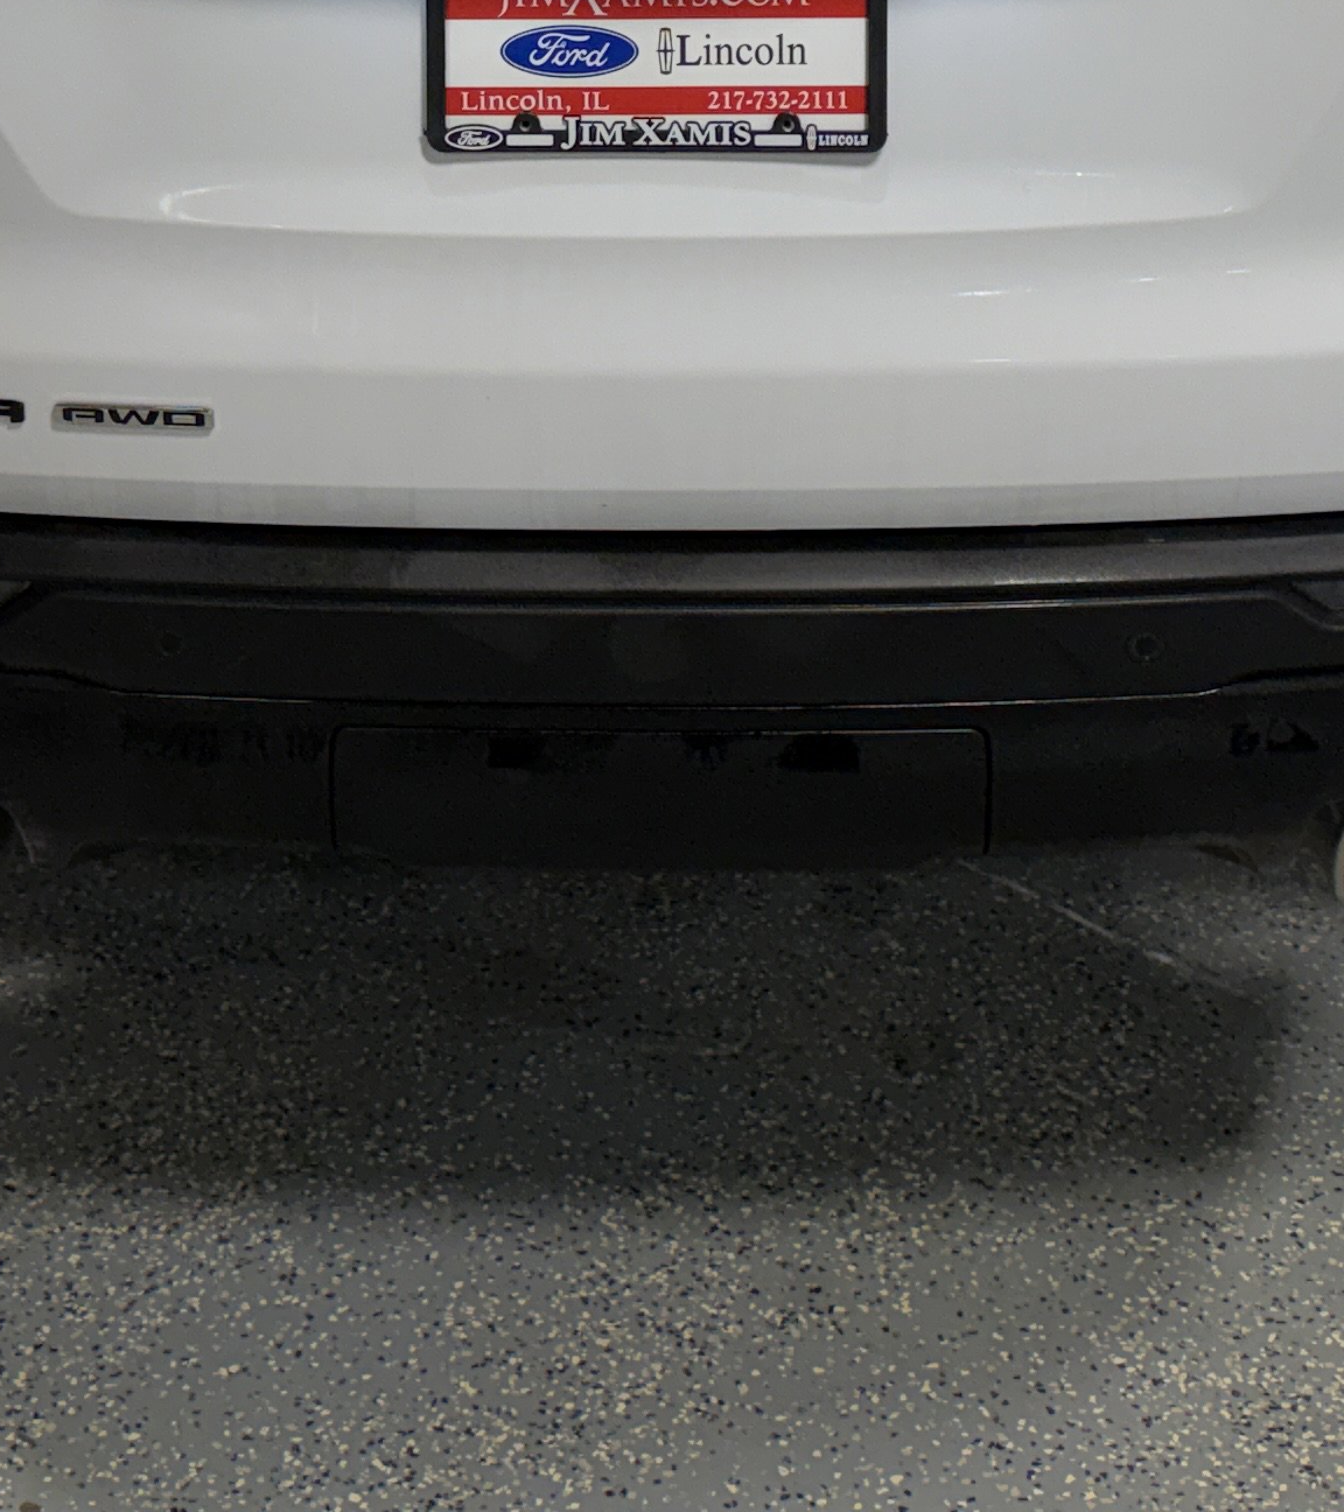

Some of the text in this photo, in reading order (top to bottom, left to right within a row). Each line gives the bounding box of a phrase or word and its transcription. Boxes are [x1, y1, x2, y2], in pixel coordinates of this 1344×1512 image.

[529, 33, 609, 68] Ford
[676, 34, 807, 67] Lincoln
[461, 90, 610, 113] Lincoln, IL
[708, 91, 848, 110] 217-732-2111
[818, 134, 869, 147] LINCOLN
[62, 406, 206, 428] AWD
